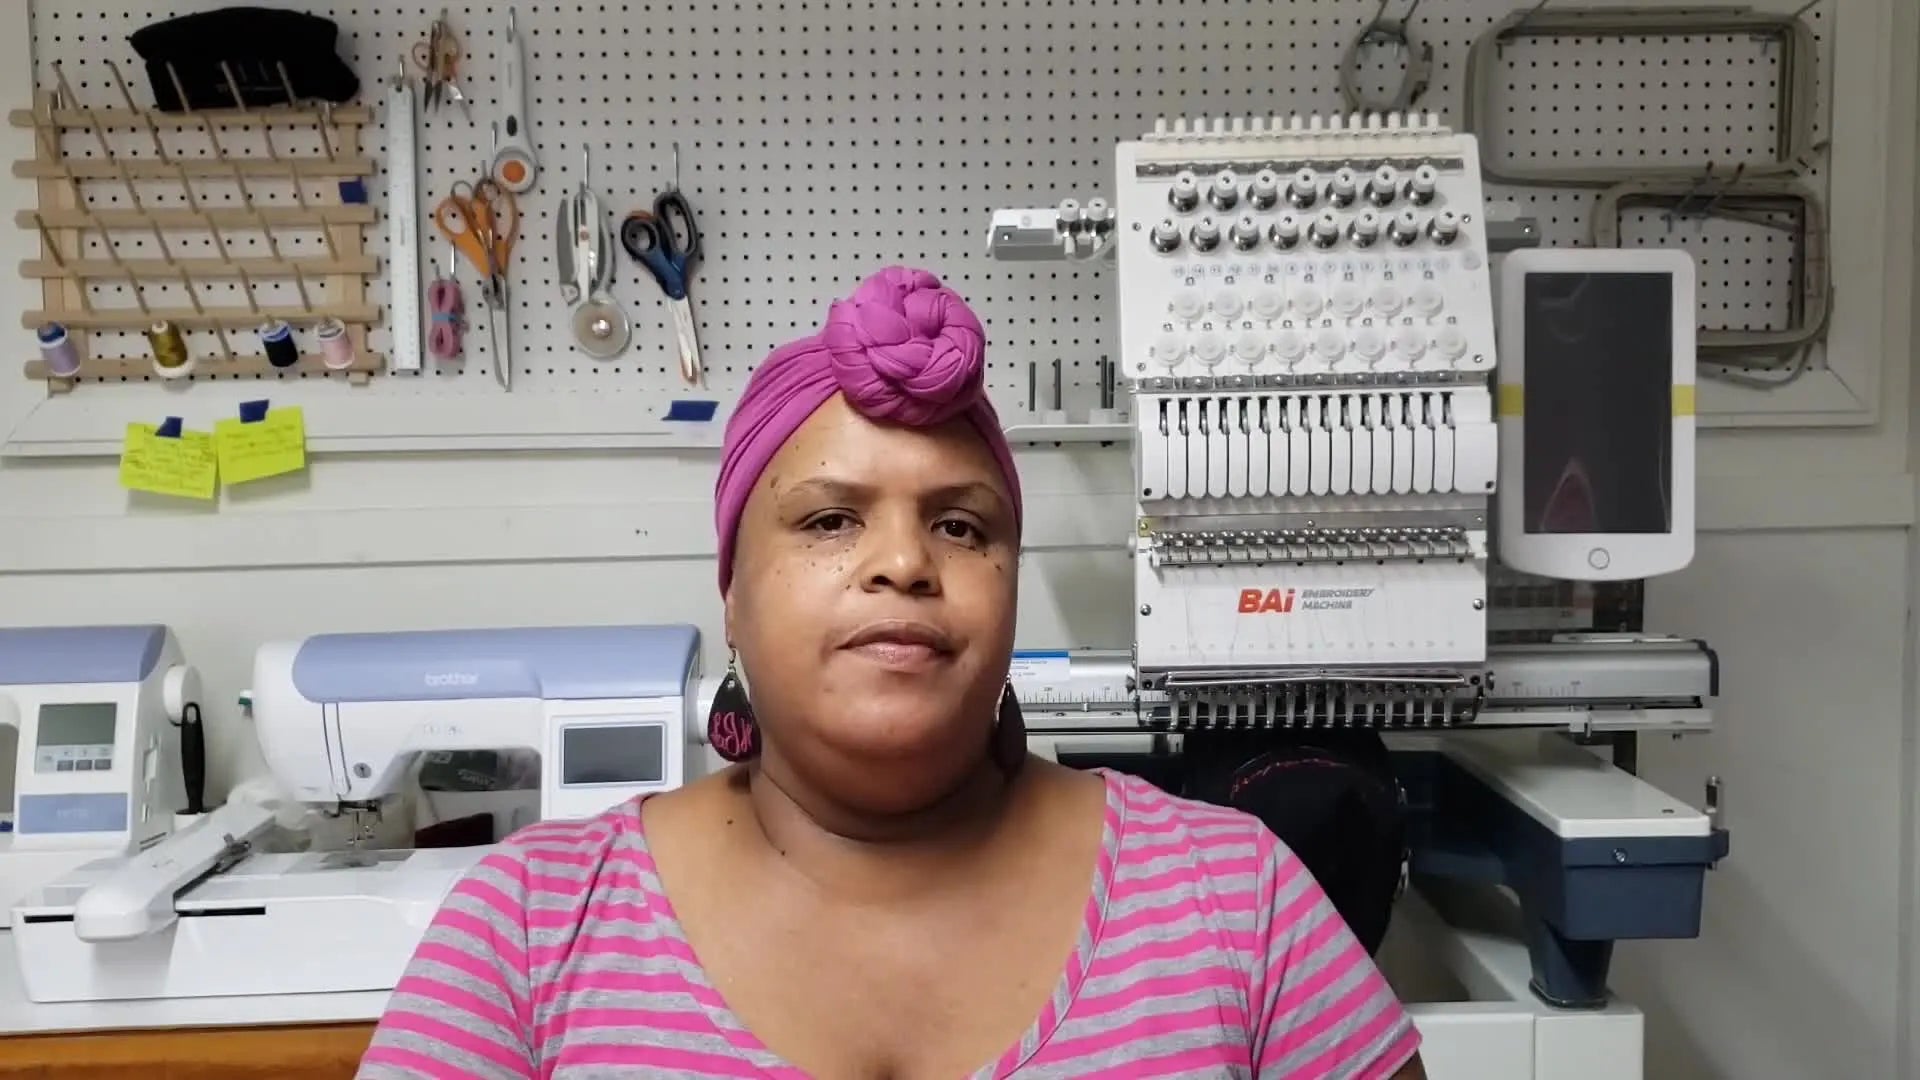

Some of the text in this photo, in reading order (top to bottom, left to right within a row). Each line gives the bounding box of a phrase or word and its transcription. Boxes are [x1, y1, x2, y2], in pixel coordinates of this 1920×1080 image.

[1301, 588, 1375, 599] EMBROIDERY
[1238, 588, 1295, 613] BAi
[1301, 600, 1353, 610] MACHINE
